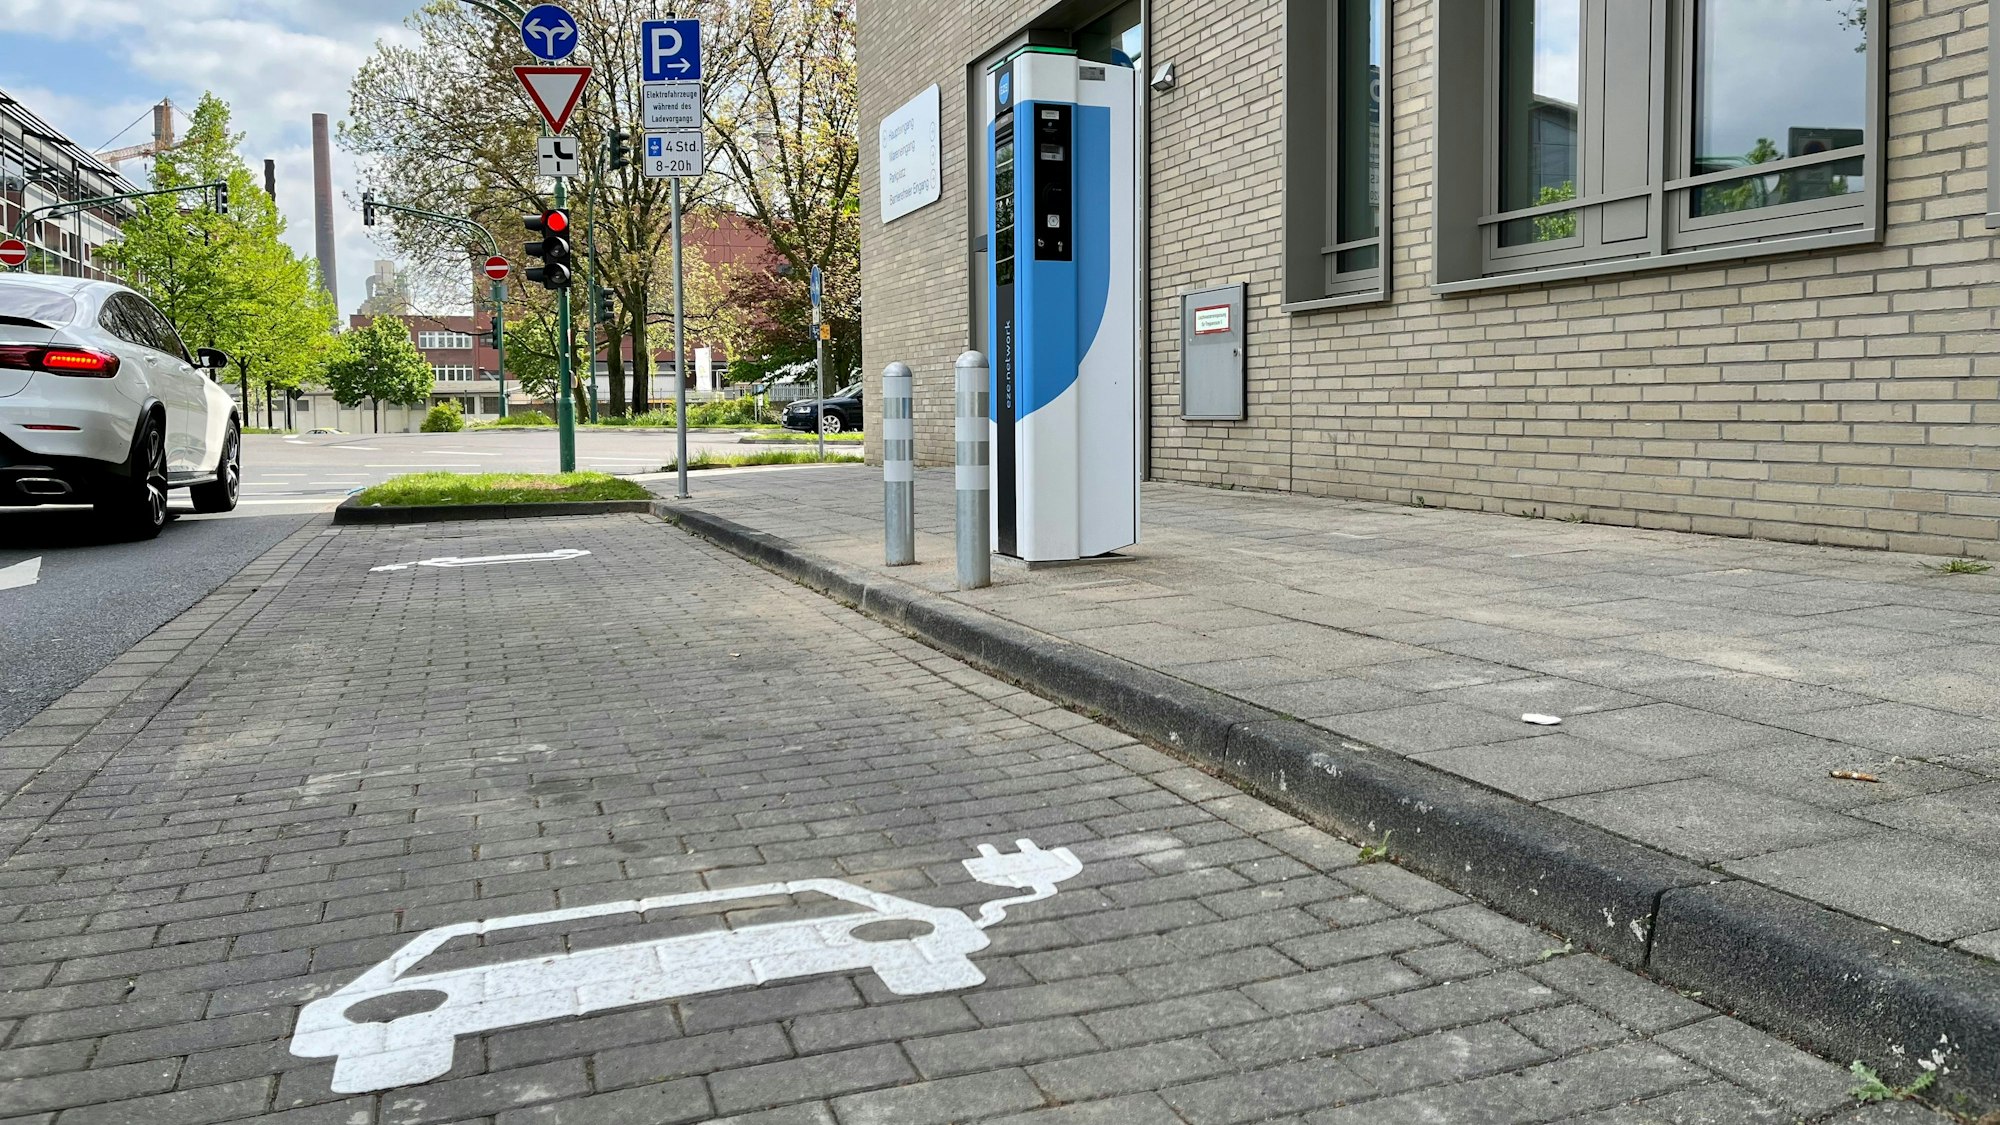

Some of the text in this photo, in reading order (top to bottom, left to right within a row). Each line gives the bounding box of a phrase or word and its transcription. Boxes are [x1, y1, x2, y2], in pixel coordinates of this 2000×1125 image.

[651, 28, 683, 74] P
[646, 90, 698, 99] Elektrofahrzeuge
[653, 102, 692, 110] während des
[651, 115, 693, 124] Ladevorgangs
[666, 140, 700, 152] 4 Std.
